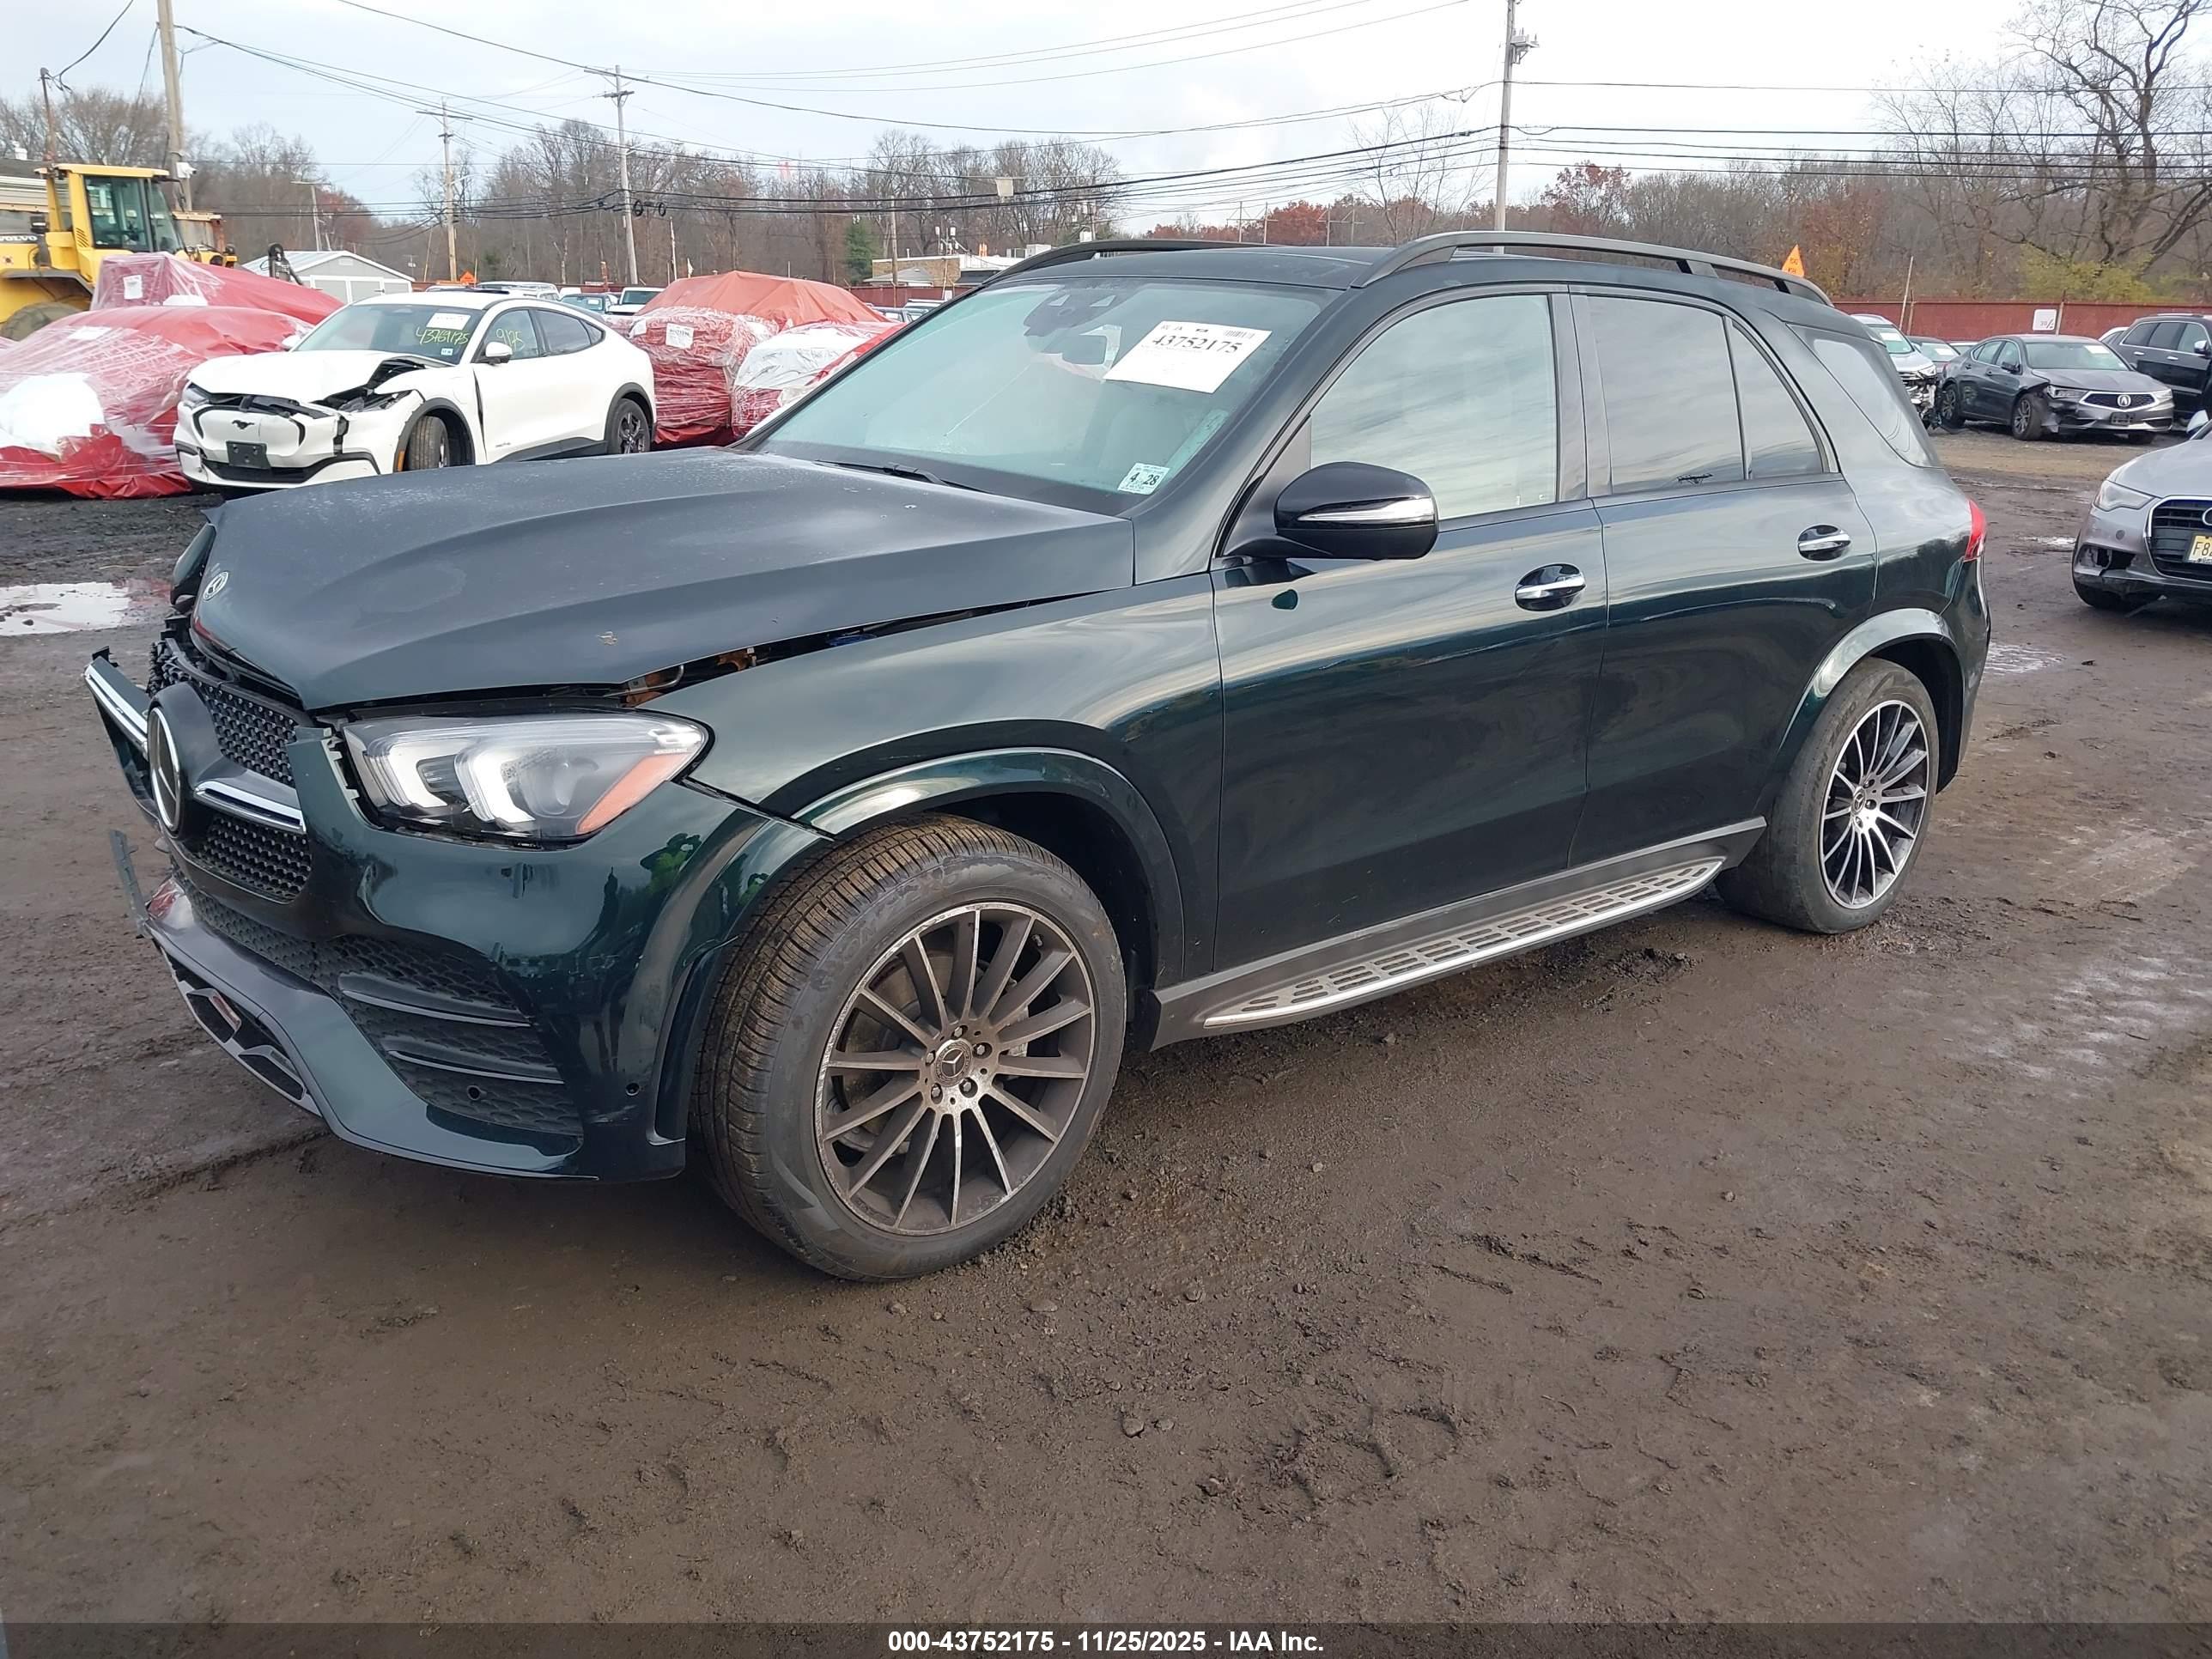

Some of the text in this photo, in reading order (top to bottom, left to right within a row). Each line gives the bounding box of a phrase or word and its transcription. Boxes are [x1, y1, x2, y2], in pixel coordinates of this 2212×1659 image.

[495, 328, 526, 351] 9175
[1152, 335, 1243, 353] 43752175
[1130, 472, 1160, 486] 4 28
